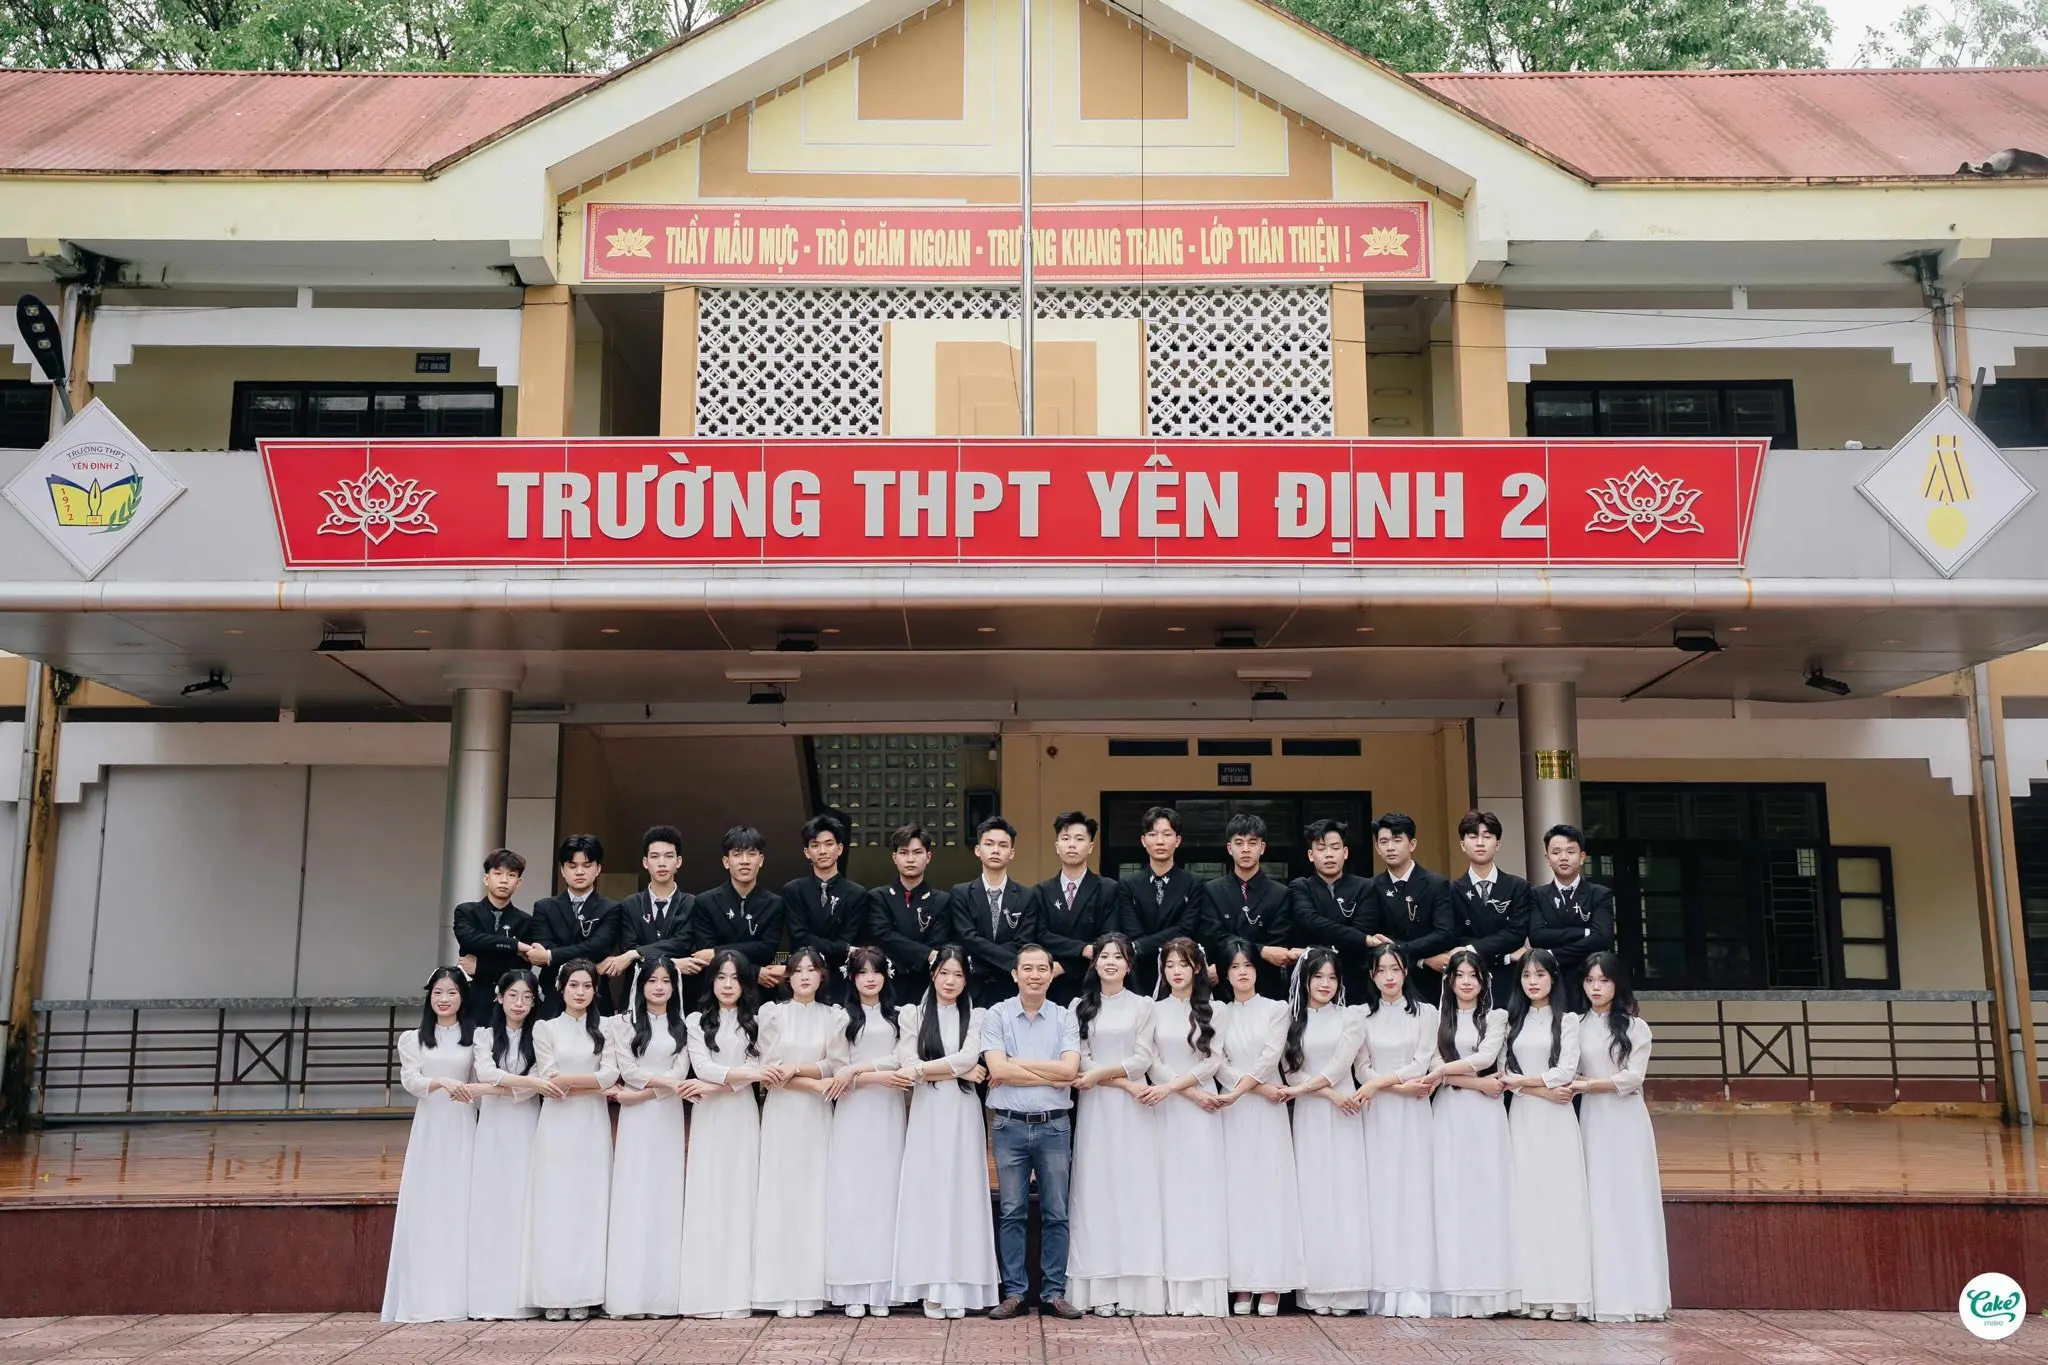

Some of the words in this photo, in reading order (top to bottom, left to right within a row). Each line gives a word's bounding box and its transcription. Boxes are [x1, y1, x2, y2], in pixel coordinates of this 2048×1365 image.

[666, 213, 710, 265] THẦY
[714, 212, 754, 265] MẪU
[758, 224, 798, 273] MỰC
[815, 219, 848, 267] TRÒ
[853, 220, 905, 266] CHĂM
[910, 228, 971, 267] NGOAN
[987, 224, 1057, 267] TRƯNG
[1061, 227, 1121, 266] KHANG
[1125, 228, 1184, 265] TRANG
[1200, 215, 1234, 265] LỚP
[1237, 218, 1284, 263] THÂN
[1288, 217, 1340, 272] THIỆN
[105, 447, 126, 459] THPT
[114, 462, 119, 470] 2
[497, 451, 821, 540] TRƯỜNG
[853, 470, 1051, 540] THPT
[1086, 454, 1239, 539] YÊN
[1274, 471, 1465, 554] ĐỊNH
[1501, 472, 1548, 540] 2
